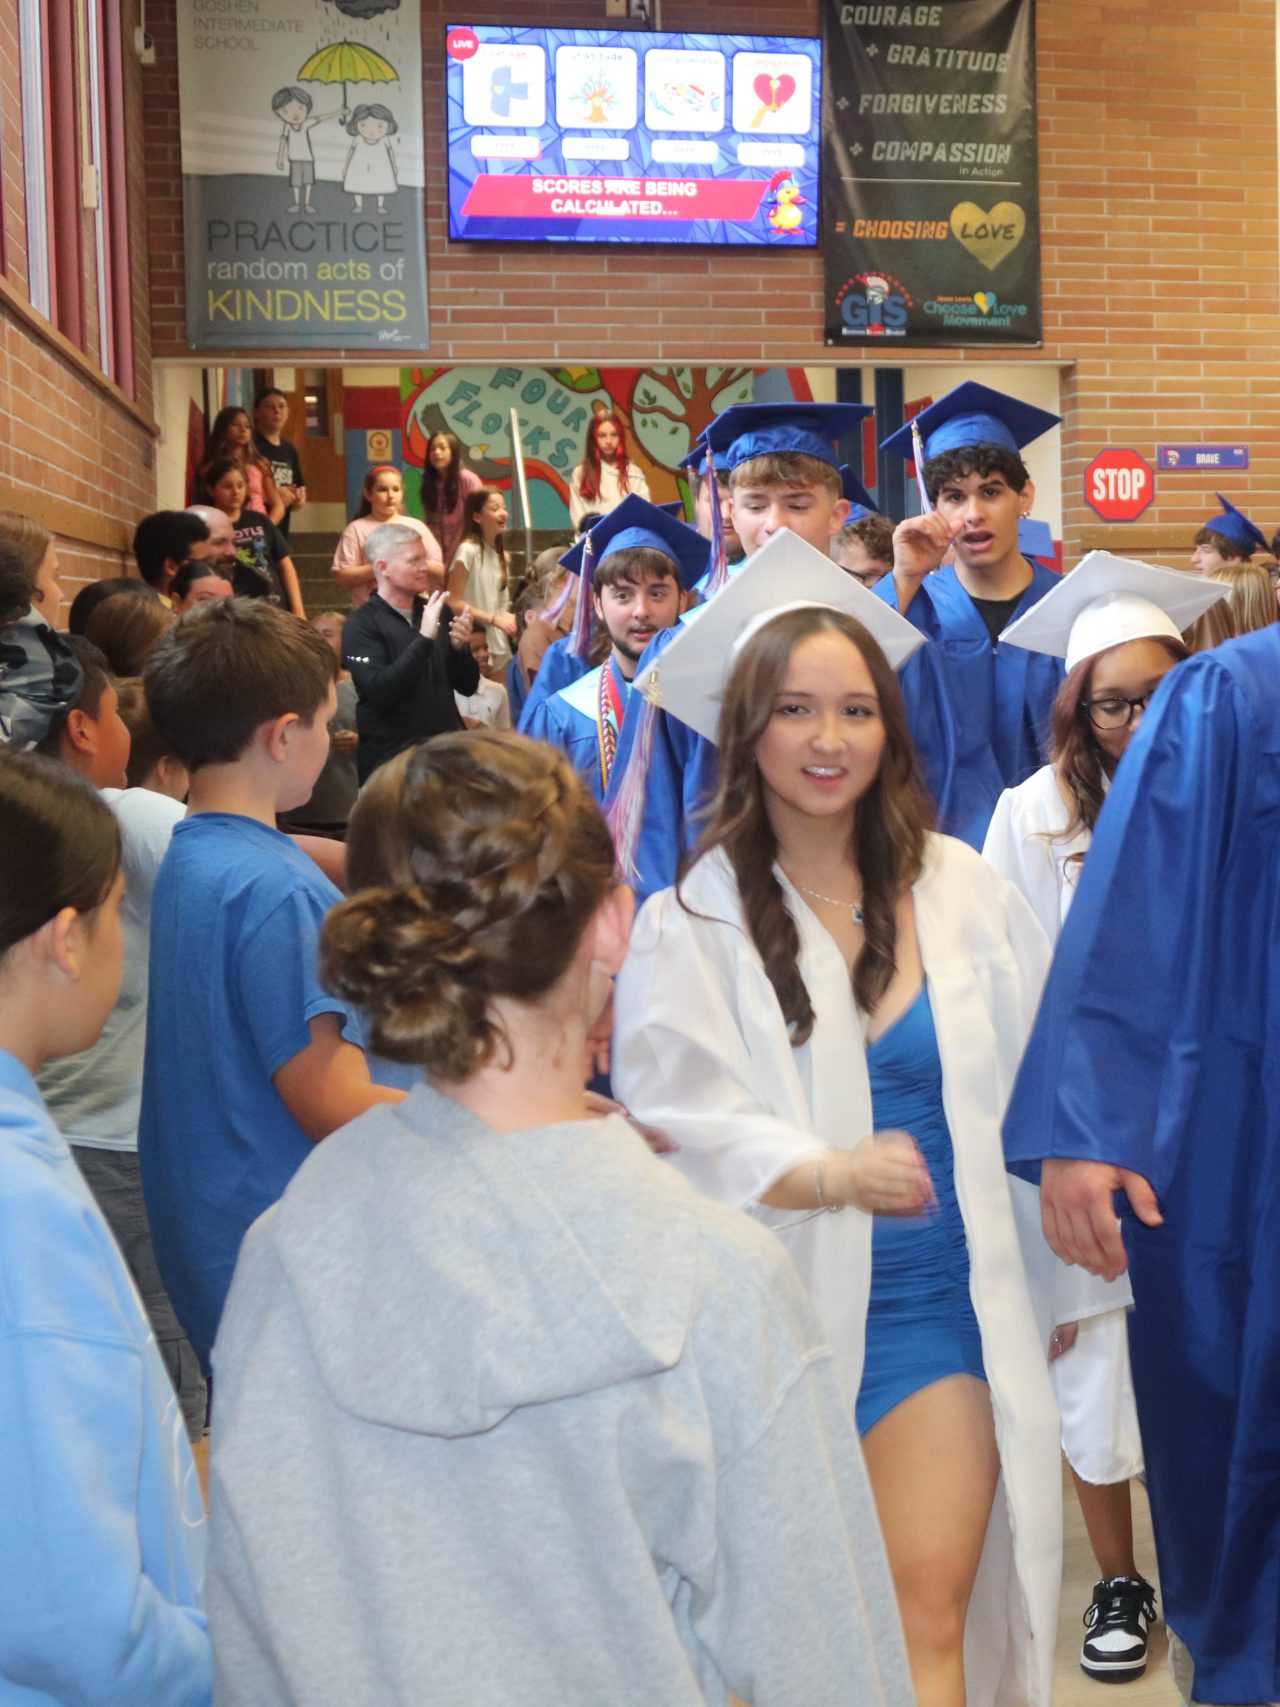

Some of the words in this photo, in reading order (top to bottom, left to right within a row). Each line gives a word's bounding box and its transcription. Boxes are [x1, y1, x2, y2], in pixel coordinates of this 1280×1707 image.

[193, 0, 259, 13] GOSHEN
[840, 5, 943, 27] COURAGE
[194, 18, 304, 33] INTERMEDIATE
[194, 35, 260, 50] SCHOOL
[453, 40, 474, 49] LIVE
[886, 43, 1010, 73] GRATITUDE
[858, 94, 1008, 115] FORGIVENESS
[872, 140, 1012, 164] COMPASSION
[959, 166, 969, 175] in
[971, 166, 1004, 177] Action
[532, 179, 602, 195] SCORES
[604, 180, 641, 195] ARE
[645, 181, 698, 196] BEING
[207, 221, 404, 252] PRACTICE
[853, 219, 949, 240] CHOOSING
[960, 222, 1016, 240] LOVE
[207, 257, 307, 281] random
[316, 258, 371, 281] acts
[379, 257, 406, 281] of
[207, 289, 407, 322] KINDNESS
[842, 293, 908, 326] GIS
[923, 300, 978, 315] Choose
[993, 303, 1028, 316] Love
[943, 315, 1011, 327] Movement
[489, 367, 587, 434] FOUR
[445, 380, 577, 469] FLOCKS
[1196, 453, 1220, 465] BRAVE
[1092, 467, 1146, 501] STOP
